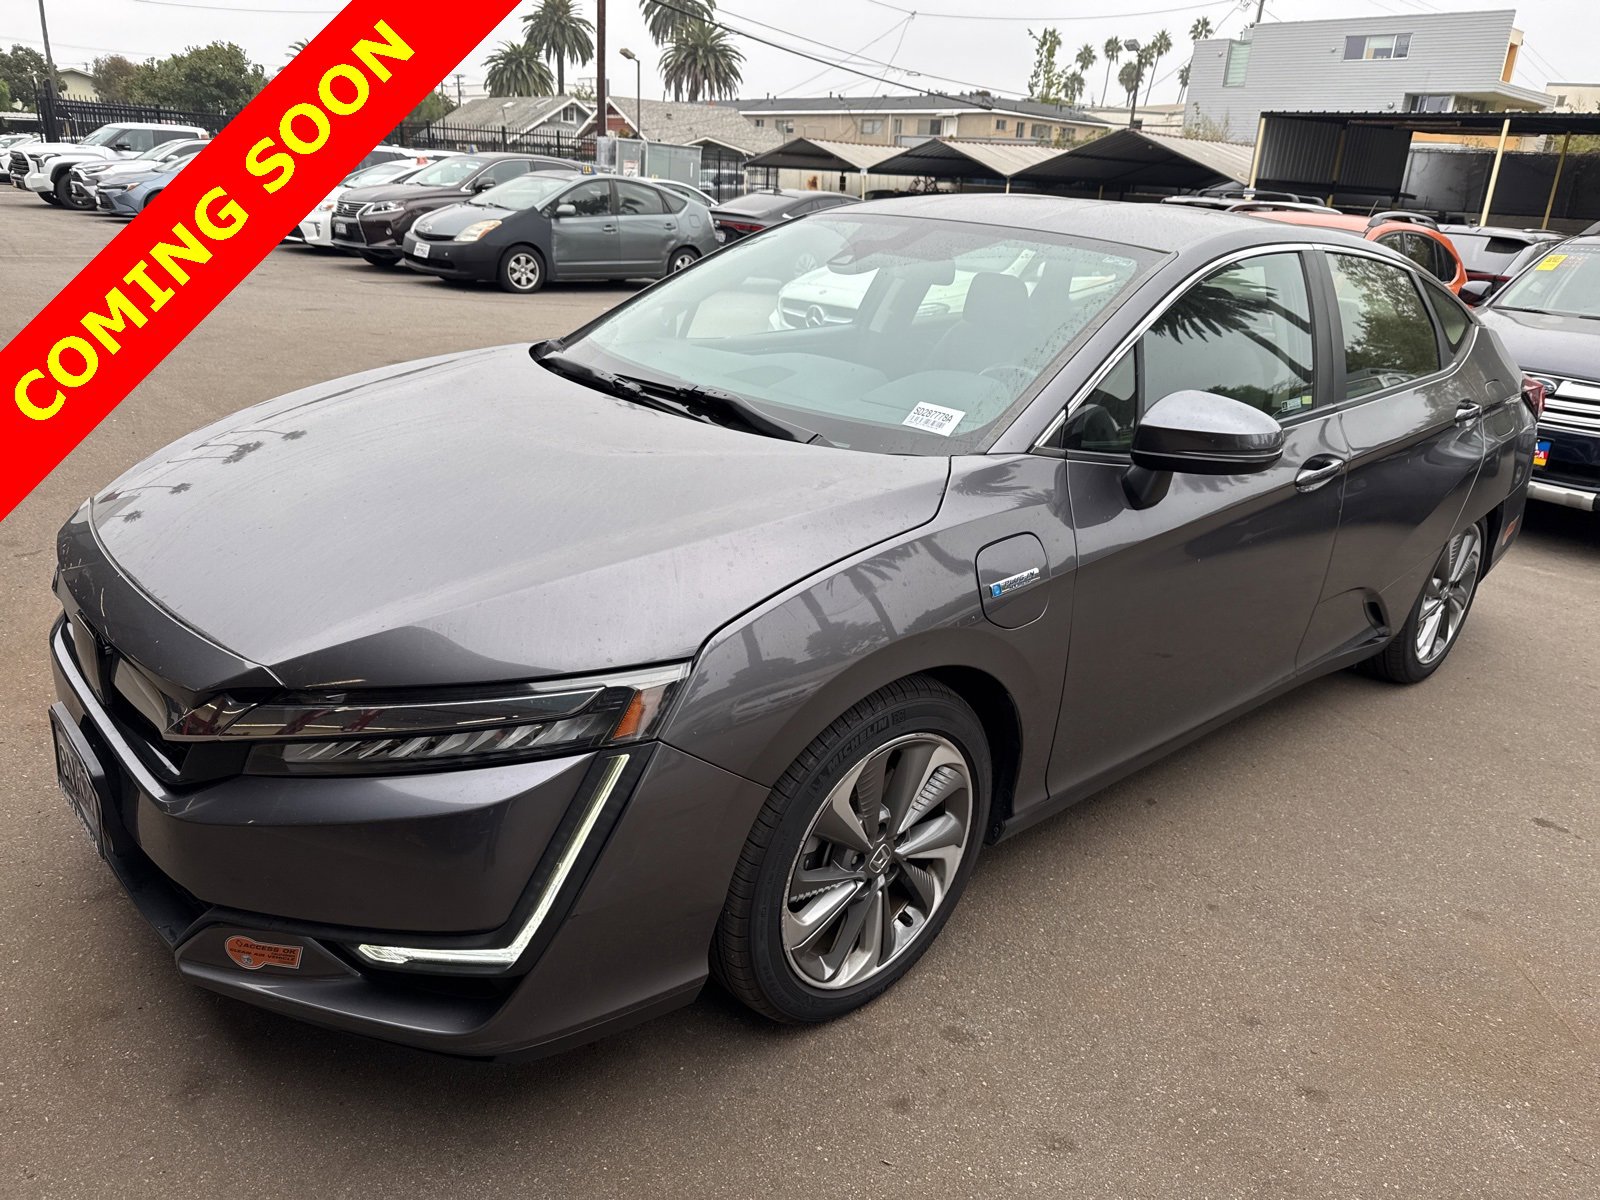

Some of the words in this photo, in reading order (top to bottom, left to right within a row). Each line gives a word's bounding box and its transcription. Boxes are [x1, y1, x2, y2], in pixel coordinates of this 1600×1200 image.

[913, 406, 953, 424] SD287778A
[827, 715, 890, 774] MICHELIN
[243, 943, 280, 953] ACCESS
[282, 947, 297, 955] OK
